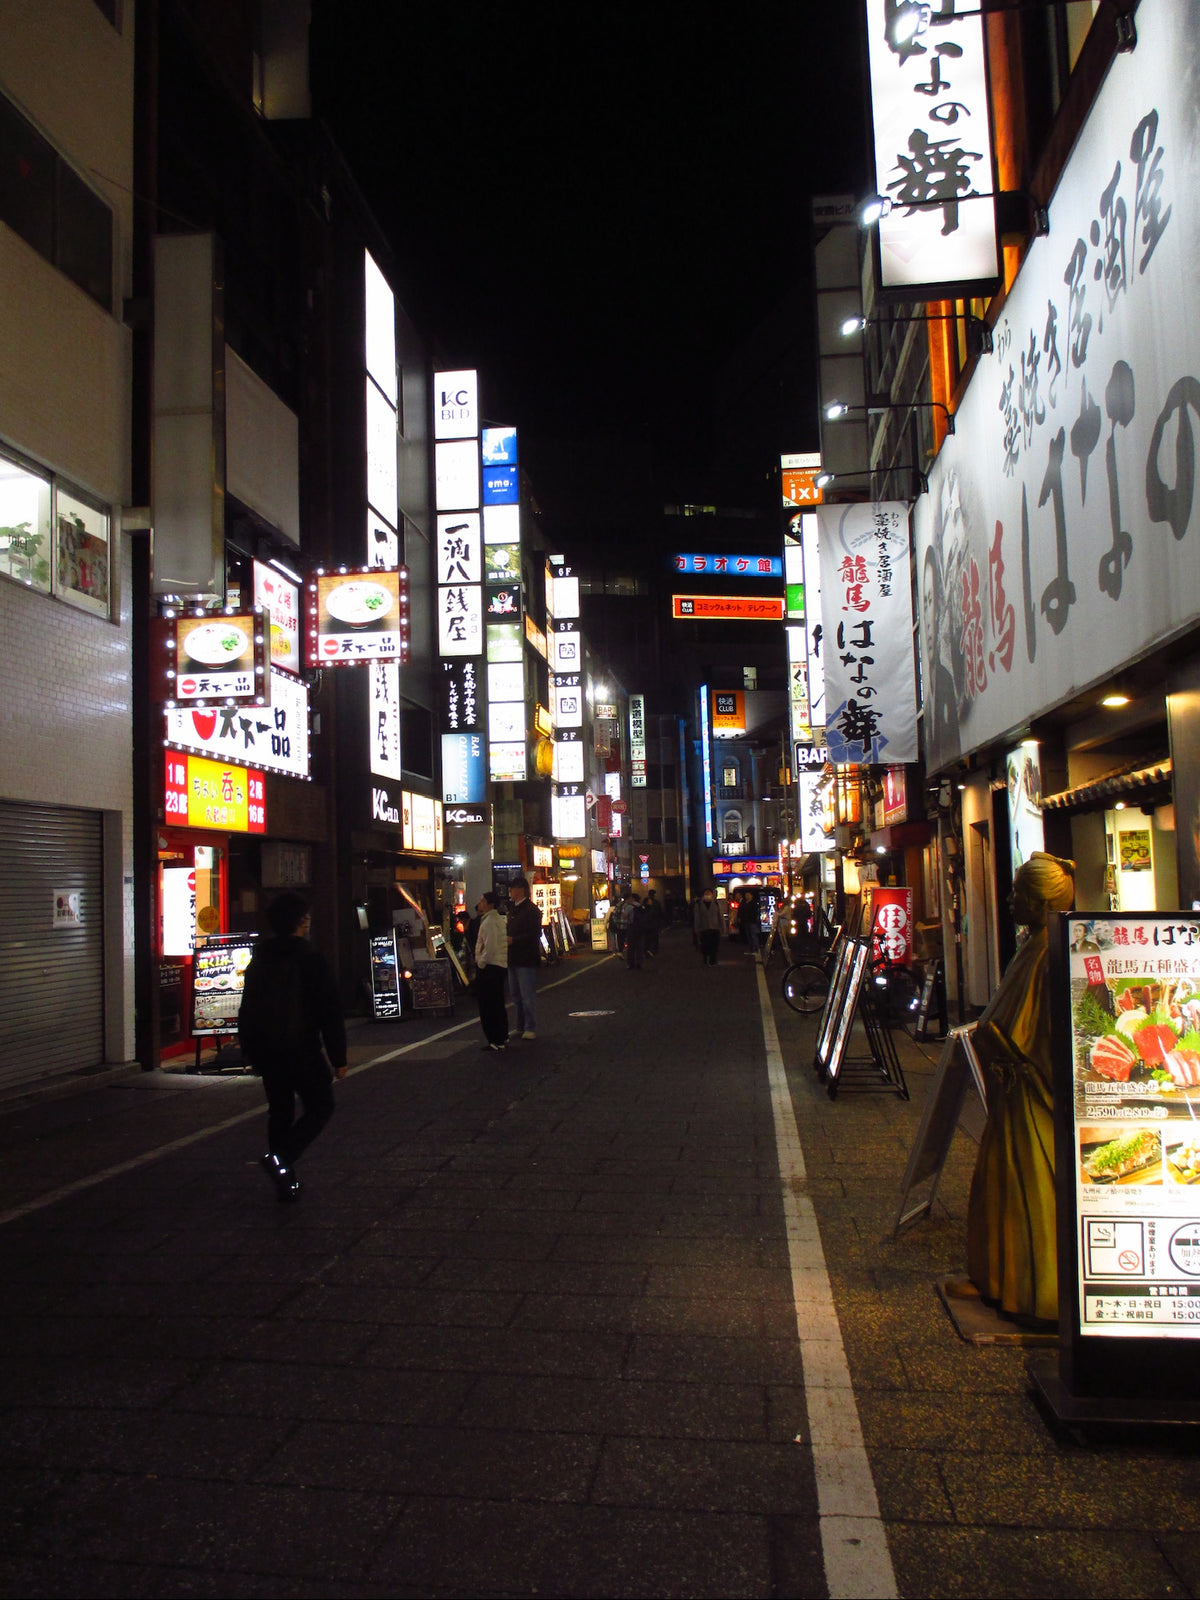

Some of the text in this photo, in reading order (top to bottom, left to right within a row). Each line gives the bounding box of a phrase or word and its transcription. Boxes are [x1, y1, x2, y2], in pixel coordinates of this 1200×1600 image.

[441, 390, 468, 407] KC
[558, 567, 572, 577] 6F
[674, 556, 772, 573] カラオケ館
[560, 622, 574, 631] 5F
[342, 637, 396, 652] 天下一品
[837, 554, 883, 754] 龍馬はなの舞
[199, 677, 251, 692] 天下一品
[219, 706, 291, 758] 天下一品
[562, 732, 576, 740] 2F
[471, 736, 480, 757] BAR
[168, 763, 185, 784] 1階
[633, 776, 645, 784] 3F
[249, 779, 263, 799] 2階
[563, 786, 578, 795] 1F
[166, 791, 188, 815] 23席
[372, 787, 389, 823] KC
[446, 794, 457, 802] B1
[446, 810, 467, 823] KC
[1111, 925, 1200, 947] 龍馬はな
[1087, 957, 1102, 982] 名物
[1149, 1286, 1188, 1296] 営業時間
